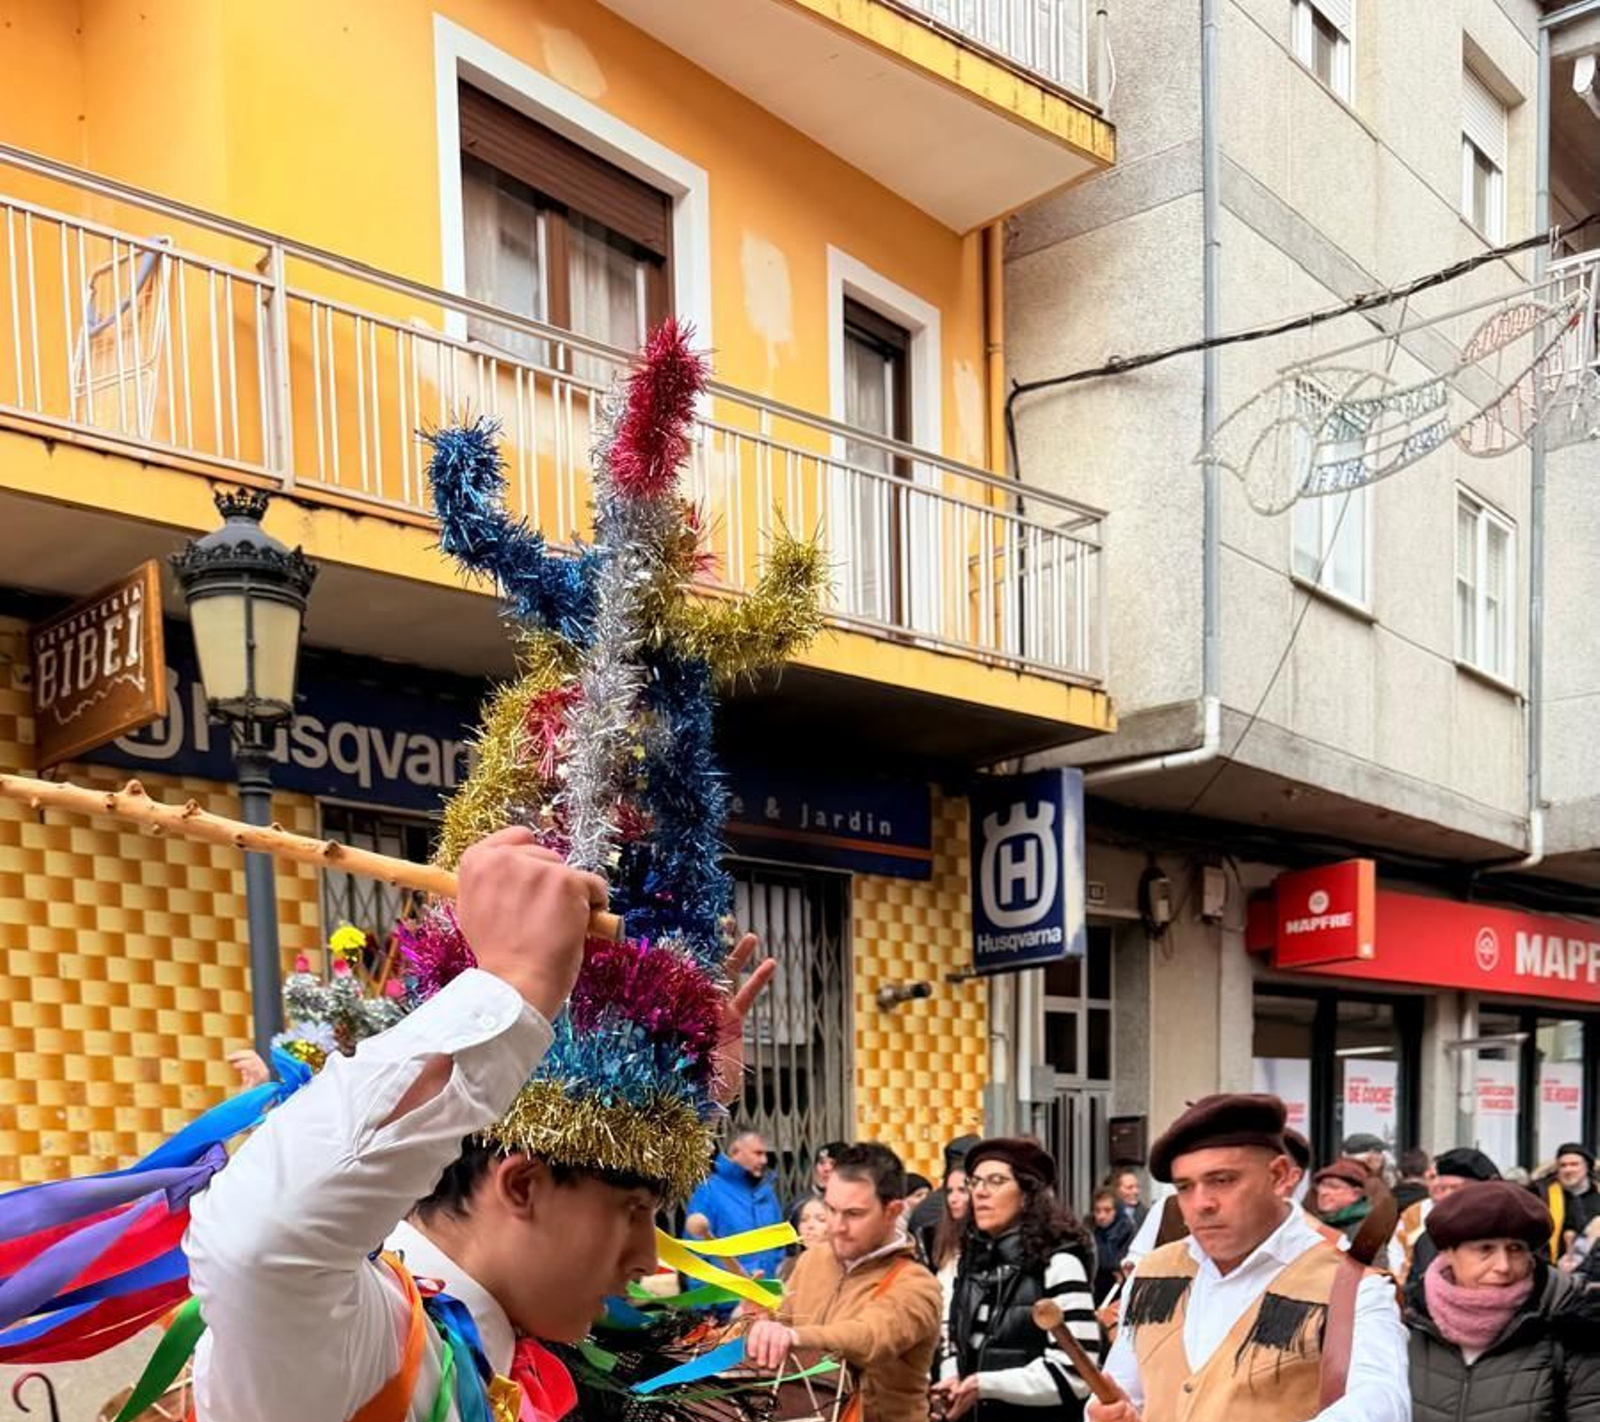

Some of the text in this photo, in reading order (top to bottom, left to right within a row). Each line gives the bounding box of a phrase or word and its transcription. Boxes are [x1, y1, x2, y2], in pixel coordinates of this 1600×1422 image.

[37, 603, 141, 709] BIBEI
[765, 797, 780, 819] &
[1000, 839, 1038, 906] H
[977, 926, 1063, 954] Husqvarna
[1286, 912, 1353, 935] MAPFRE
[1515, 931, 1600, 984] MAPF
